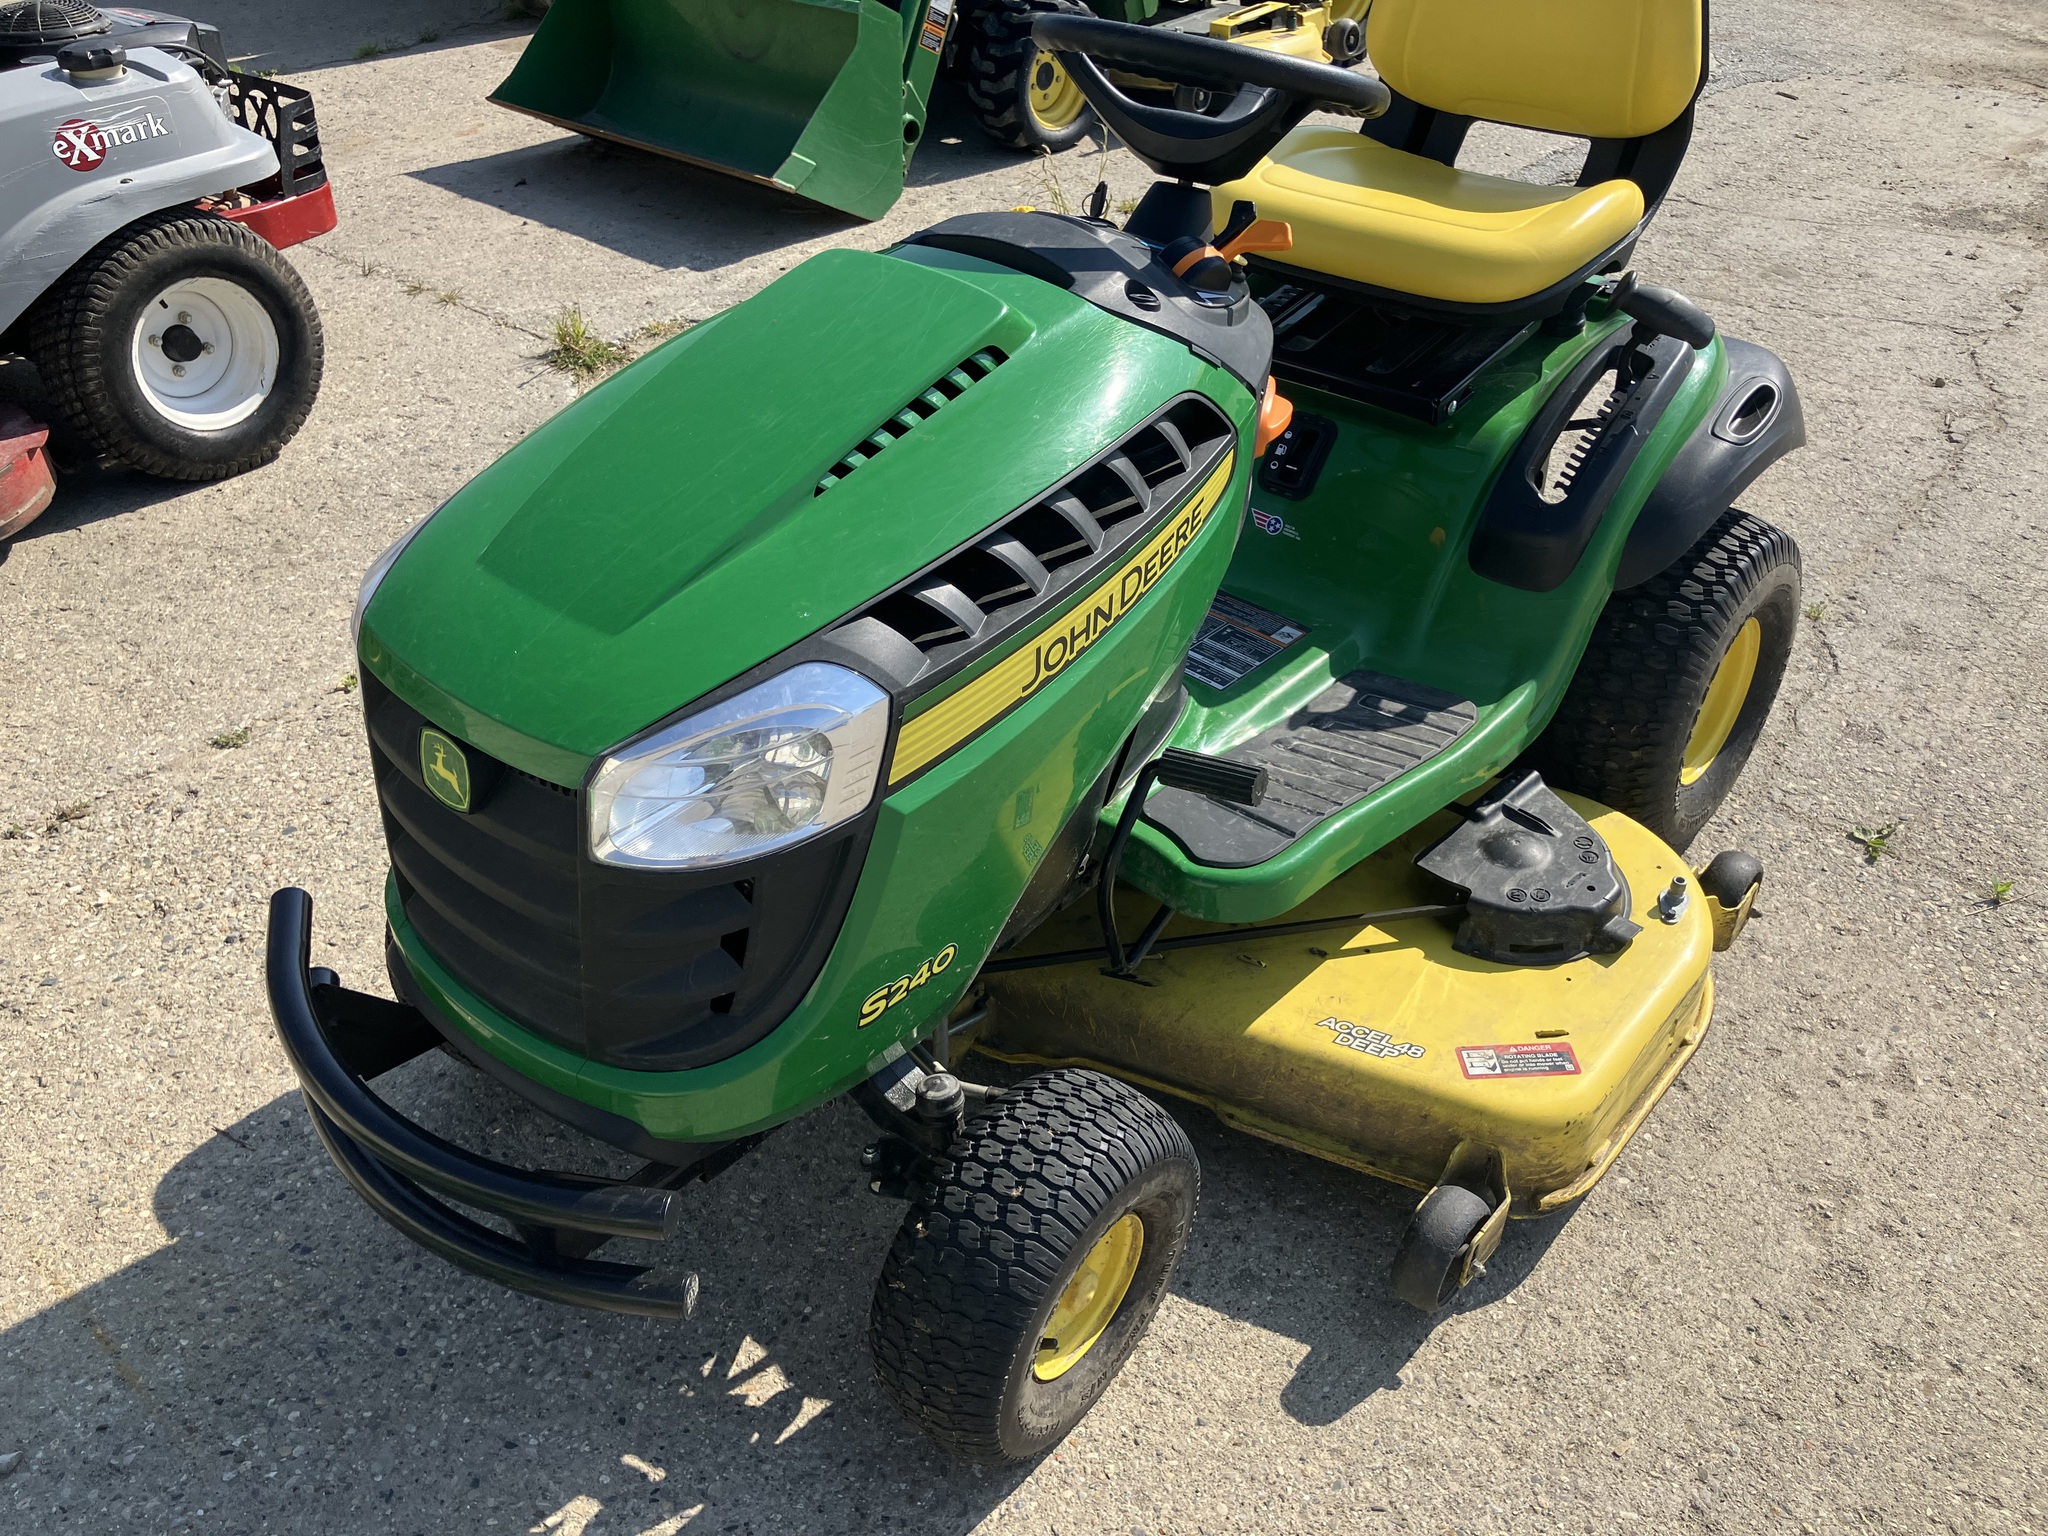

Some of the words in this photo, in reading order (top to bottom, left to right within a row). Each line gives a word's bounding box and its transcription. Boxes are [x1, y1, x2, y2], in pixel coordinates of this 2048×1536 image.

[52, 112, 169, 166] eXmark
[1022, 592, 1114, 694] JOHN
[1119, 496, 1205, 614] DEERE
[857, 944, 958, 1030] S240
[1315, 1016, 1394, 1048] ACCEL
[1393, 1042, 1426, 1058] 48
[1333, 1033, 1401, 1058] DEEP
[1517, 1044, 1552, 1052] DANGER
